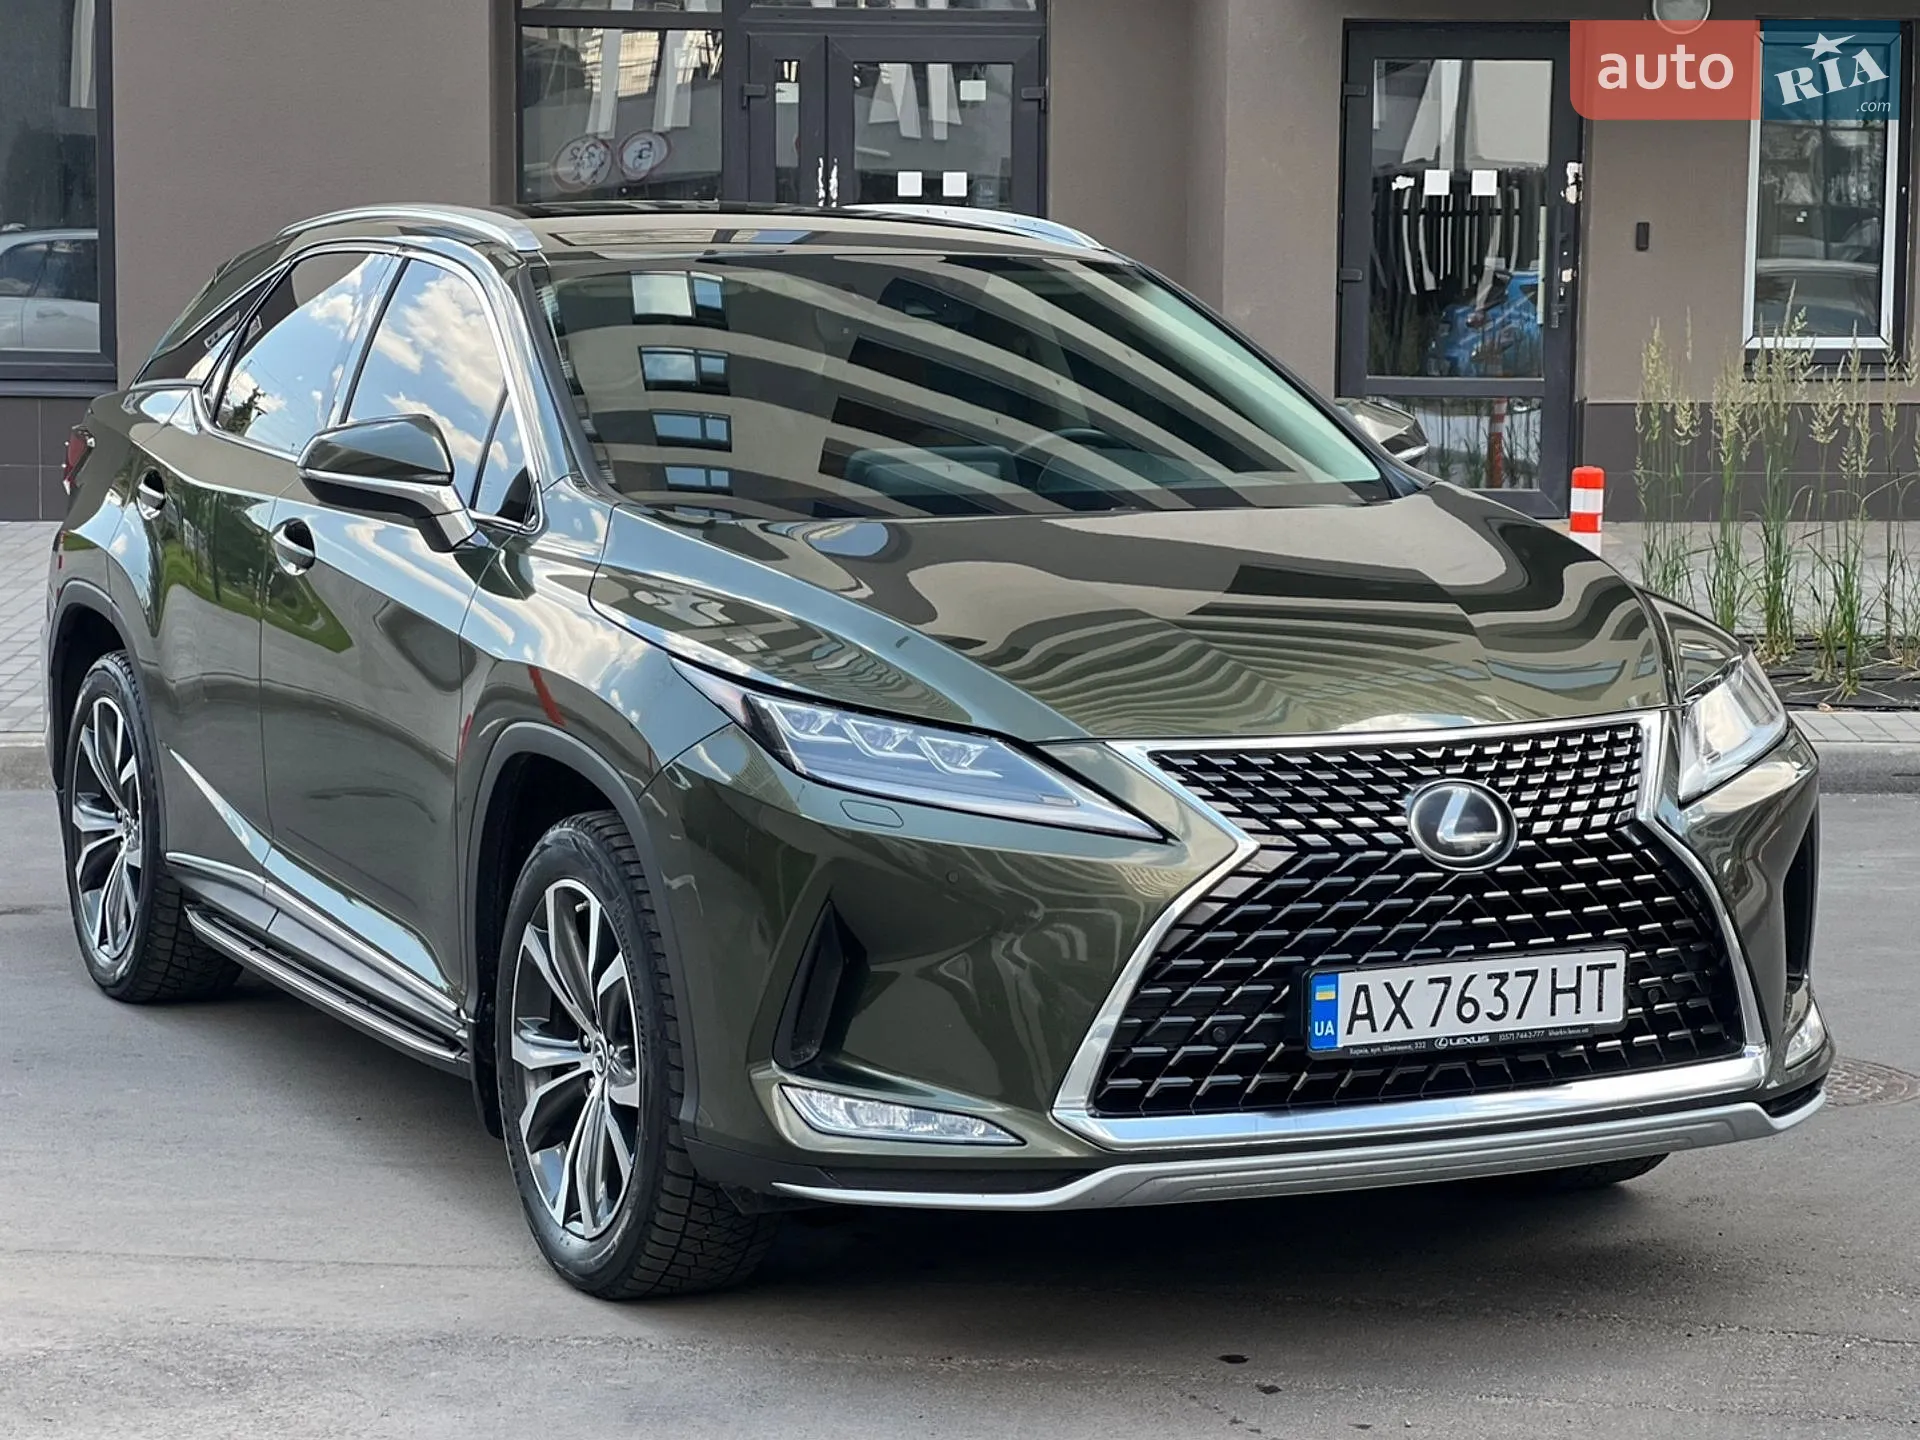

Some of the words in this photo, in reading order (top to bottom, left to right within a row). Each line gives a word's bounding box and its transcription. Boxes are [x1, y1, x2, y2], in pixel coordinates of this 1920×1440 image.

[1346, 979, 1415, 1036] AX
[1427, 968, 1540, 1028] 7637
[1549, 962, 1618, 1017] HT
[1314, 1020, 1335, 1036] UA
[1449, 1035, 1490, 1046] LEXUS
